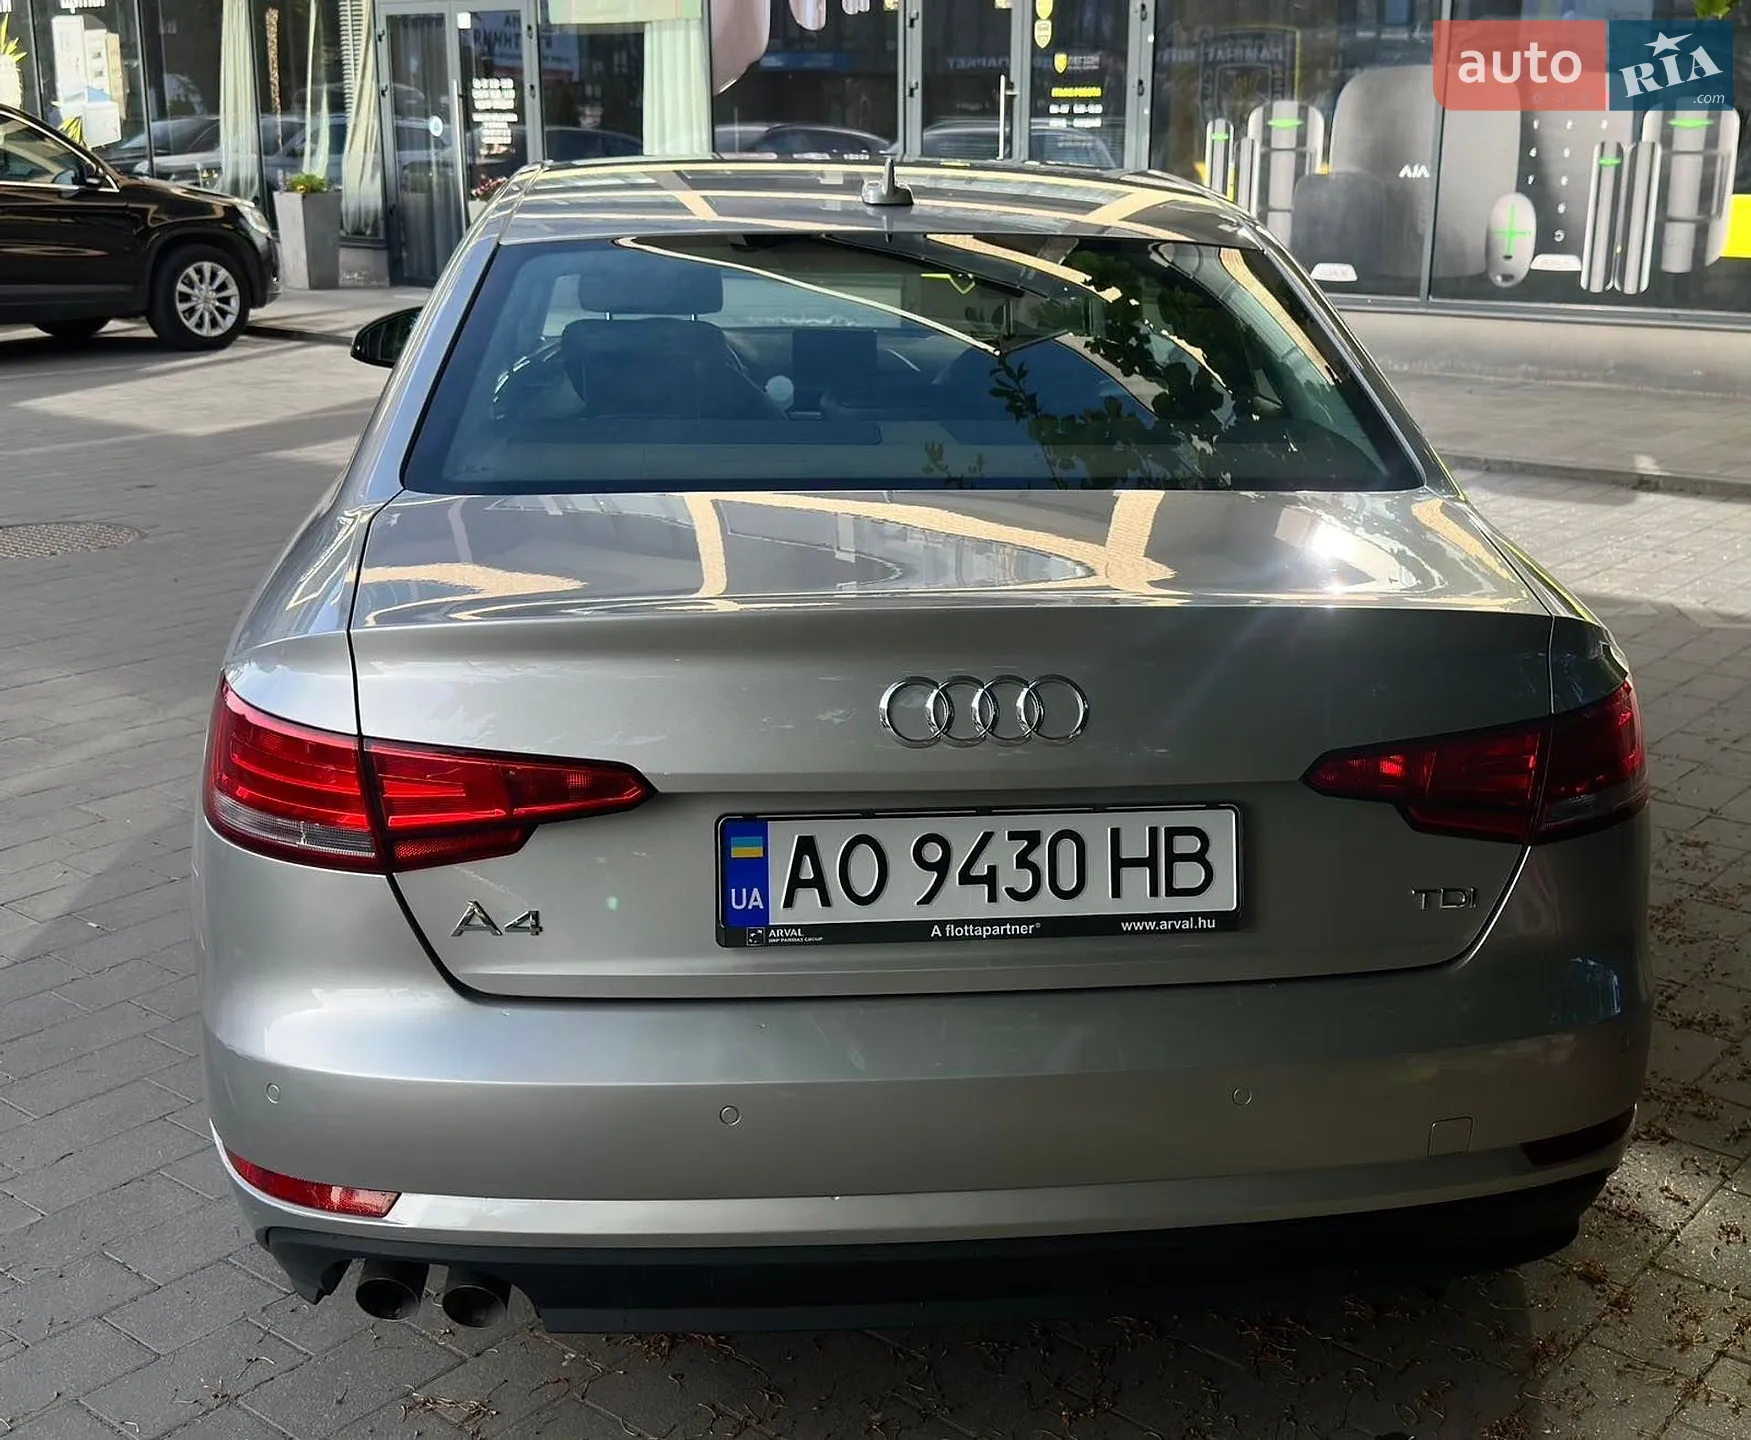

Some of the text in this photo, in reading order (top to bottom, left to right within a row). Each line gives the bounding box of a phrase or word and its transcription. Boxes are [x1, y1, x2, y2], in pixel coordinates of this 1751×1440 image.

[781, 826, 1214, 909] AO 9430 HB
[731, 888, 764, 909] UA
[1411, 886, 1477, 910] TDI
[450, 901, 543, 936] A4
[1121, 917, 1216, 931] www.arval.hu
[768, 928, 804, 937] ARVAL
[931, 925, 942, 937] A
